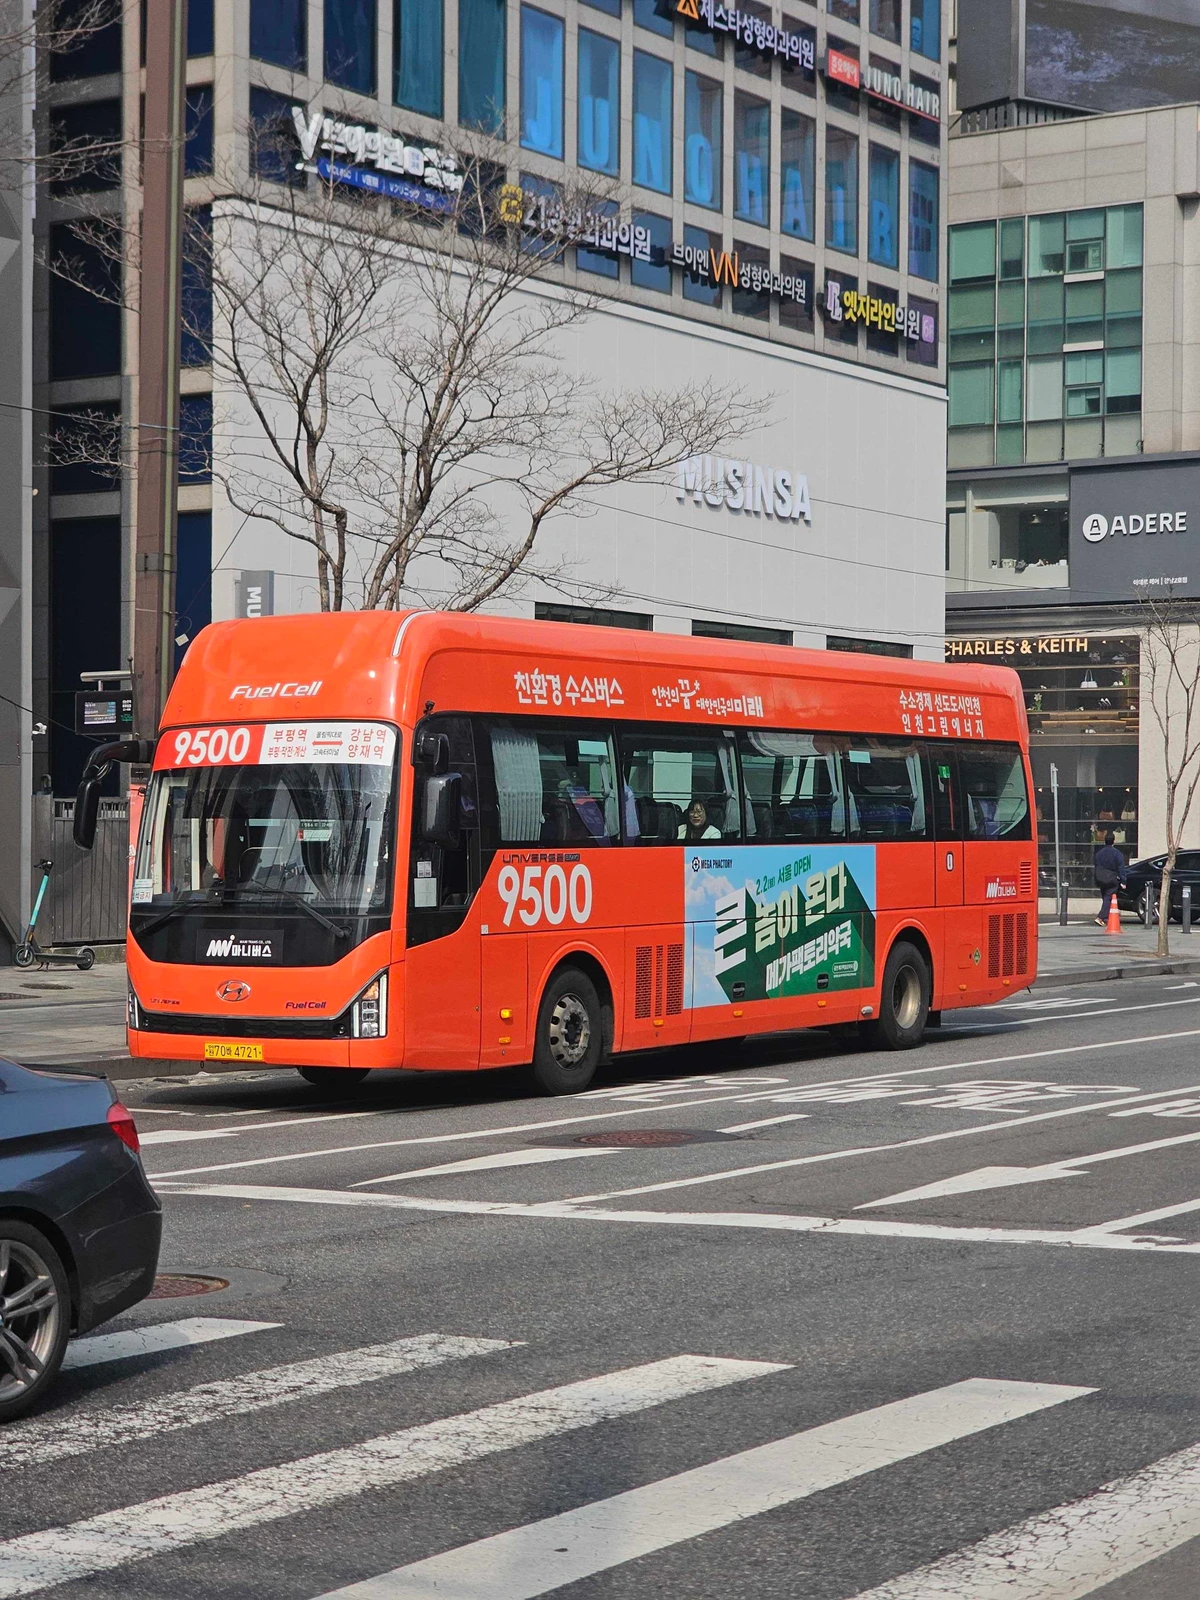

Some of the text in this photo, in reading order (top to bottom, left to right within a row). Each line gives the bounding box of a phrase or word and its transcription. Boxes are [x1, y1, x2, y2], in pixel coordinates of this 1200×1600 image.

[700, 0, 814, 70] 제스타성형외과의원
[864, 65, 940, 118] JUNO HAIR
[710, 248, 738, 288] VN
[739, 262, 806, 304] 성형외과의원
[676, 452, 812, 521] MUSINSA
[1110, 512, 1187, 536] ADERE
[1020, 639, 1032, 654] &
[1038, 638, 1088, 654] KEITH
[230, 681, 323, 700] Fuel Cell
[514, 667, 625, 708] 친환경 수소버스
[652, 685, 680, 708] 인천의
[734, 695, 764, 718] 미래
[899, 690, 933, 712] 수소경제
[174, 727, 251, 766] 9500
[273, 728, 308, 743] 부평역
[350, 728, 387, 744] 강남역
[347, 744, 384, 760] 양재역
[502, 853, 564, 864] UNIVERSE
[700, 859, 712, 869] MEGA
[778, 863, 792, 885] 서울
[793, 854, 812, 877] OPEN
[497, 864, 593, 928] 9500
[755, 885, 799, 954] 놈이
[805, 861, 848, 927] 온다
[231, 944, 272, 957] 마니버스
[285, 1001, 327, 1009] Fuel Cell
[234, 1046, 258, 1058] 4721
